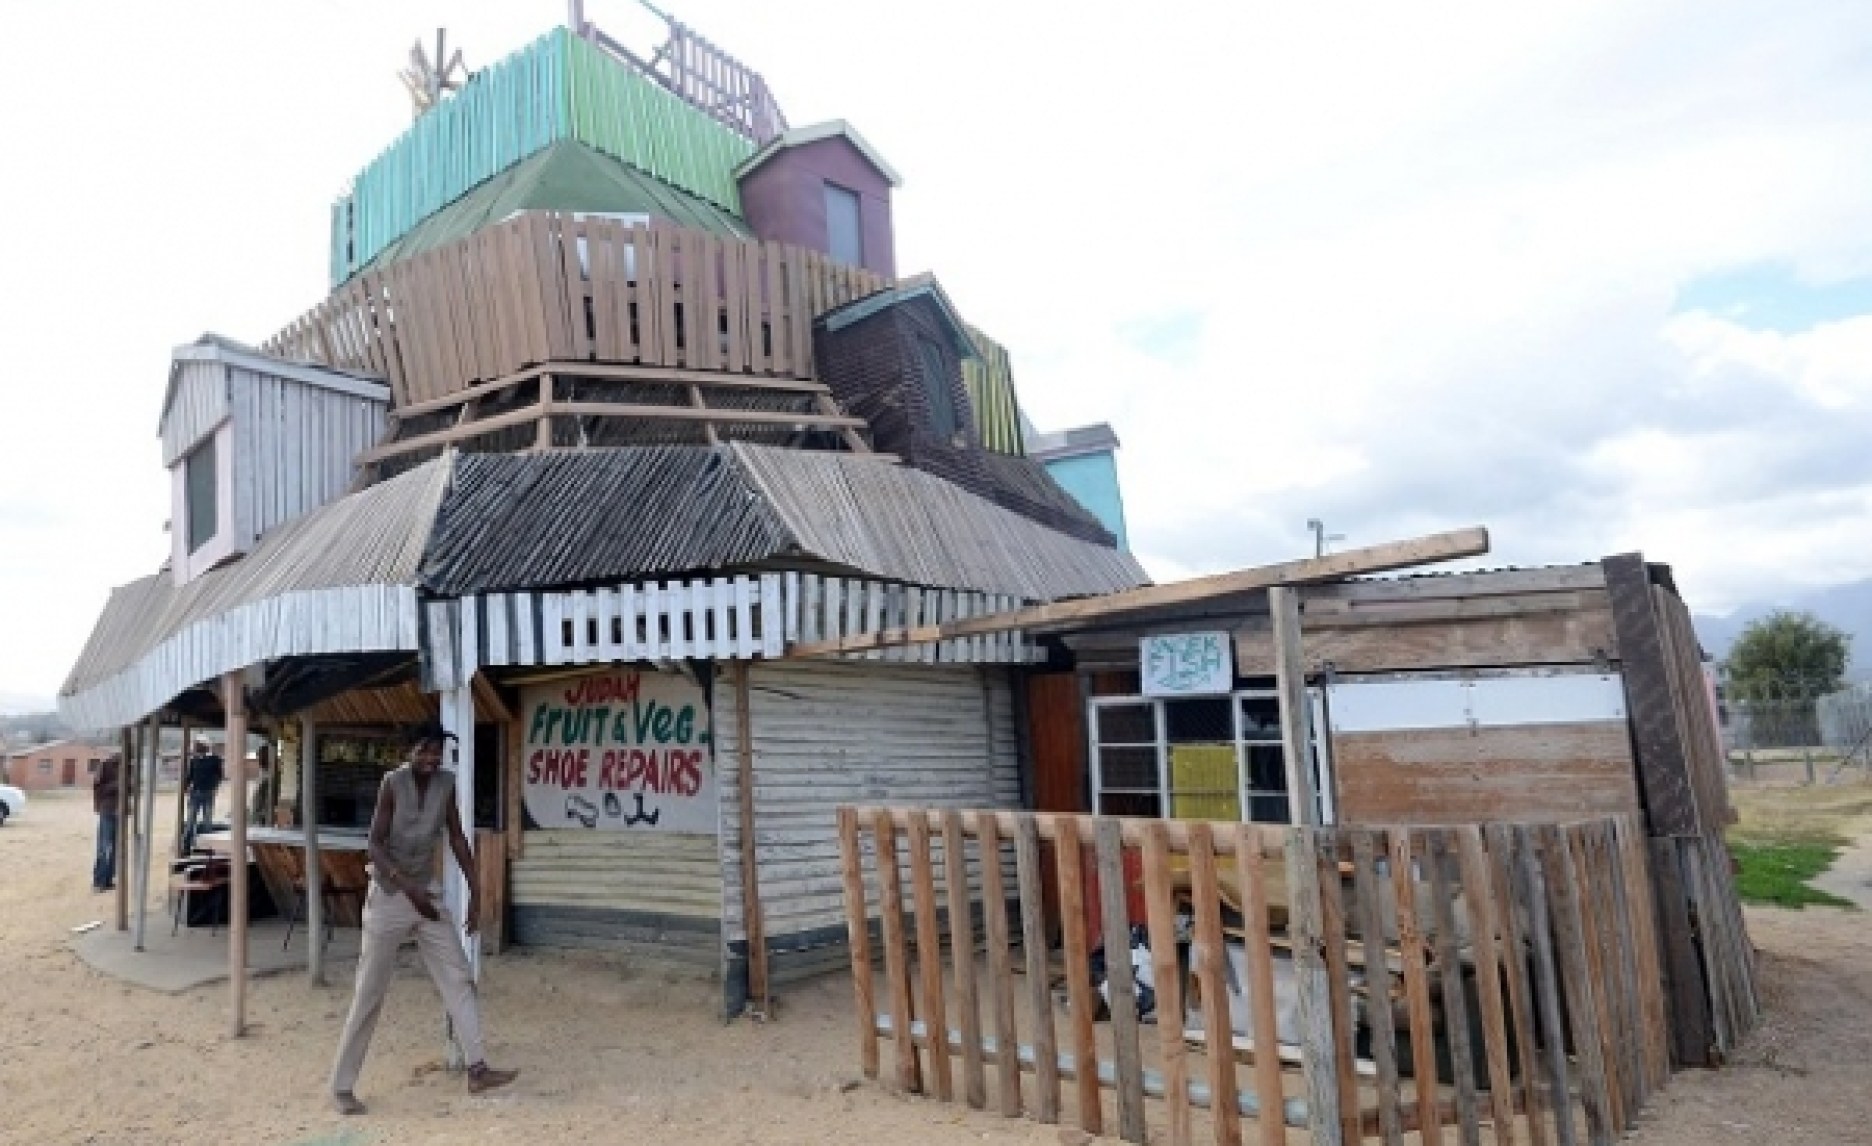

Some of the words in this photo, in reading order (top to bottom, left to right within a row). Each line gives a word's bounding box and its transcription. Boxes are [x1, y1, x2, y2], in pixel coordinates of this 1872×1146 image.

[1148, 651, 1223, 678] FISH
[612, 711, 627, 743] &
[527, 749, 590, 790] SHOE
[600, 749, 703, 796] REPAIRS
